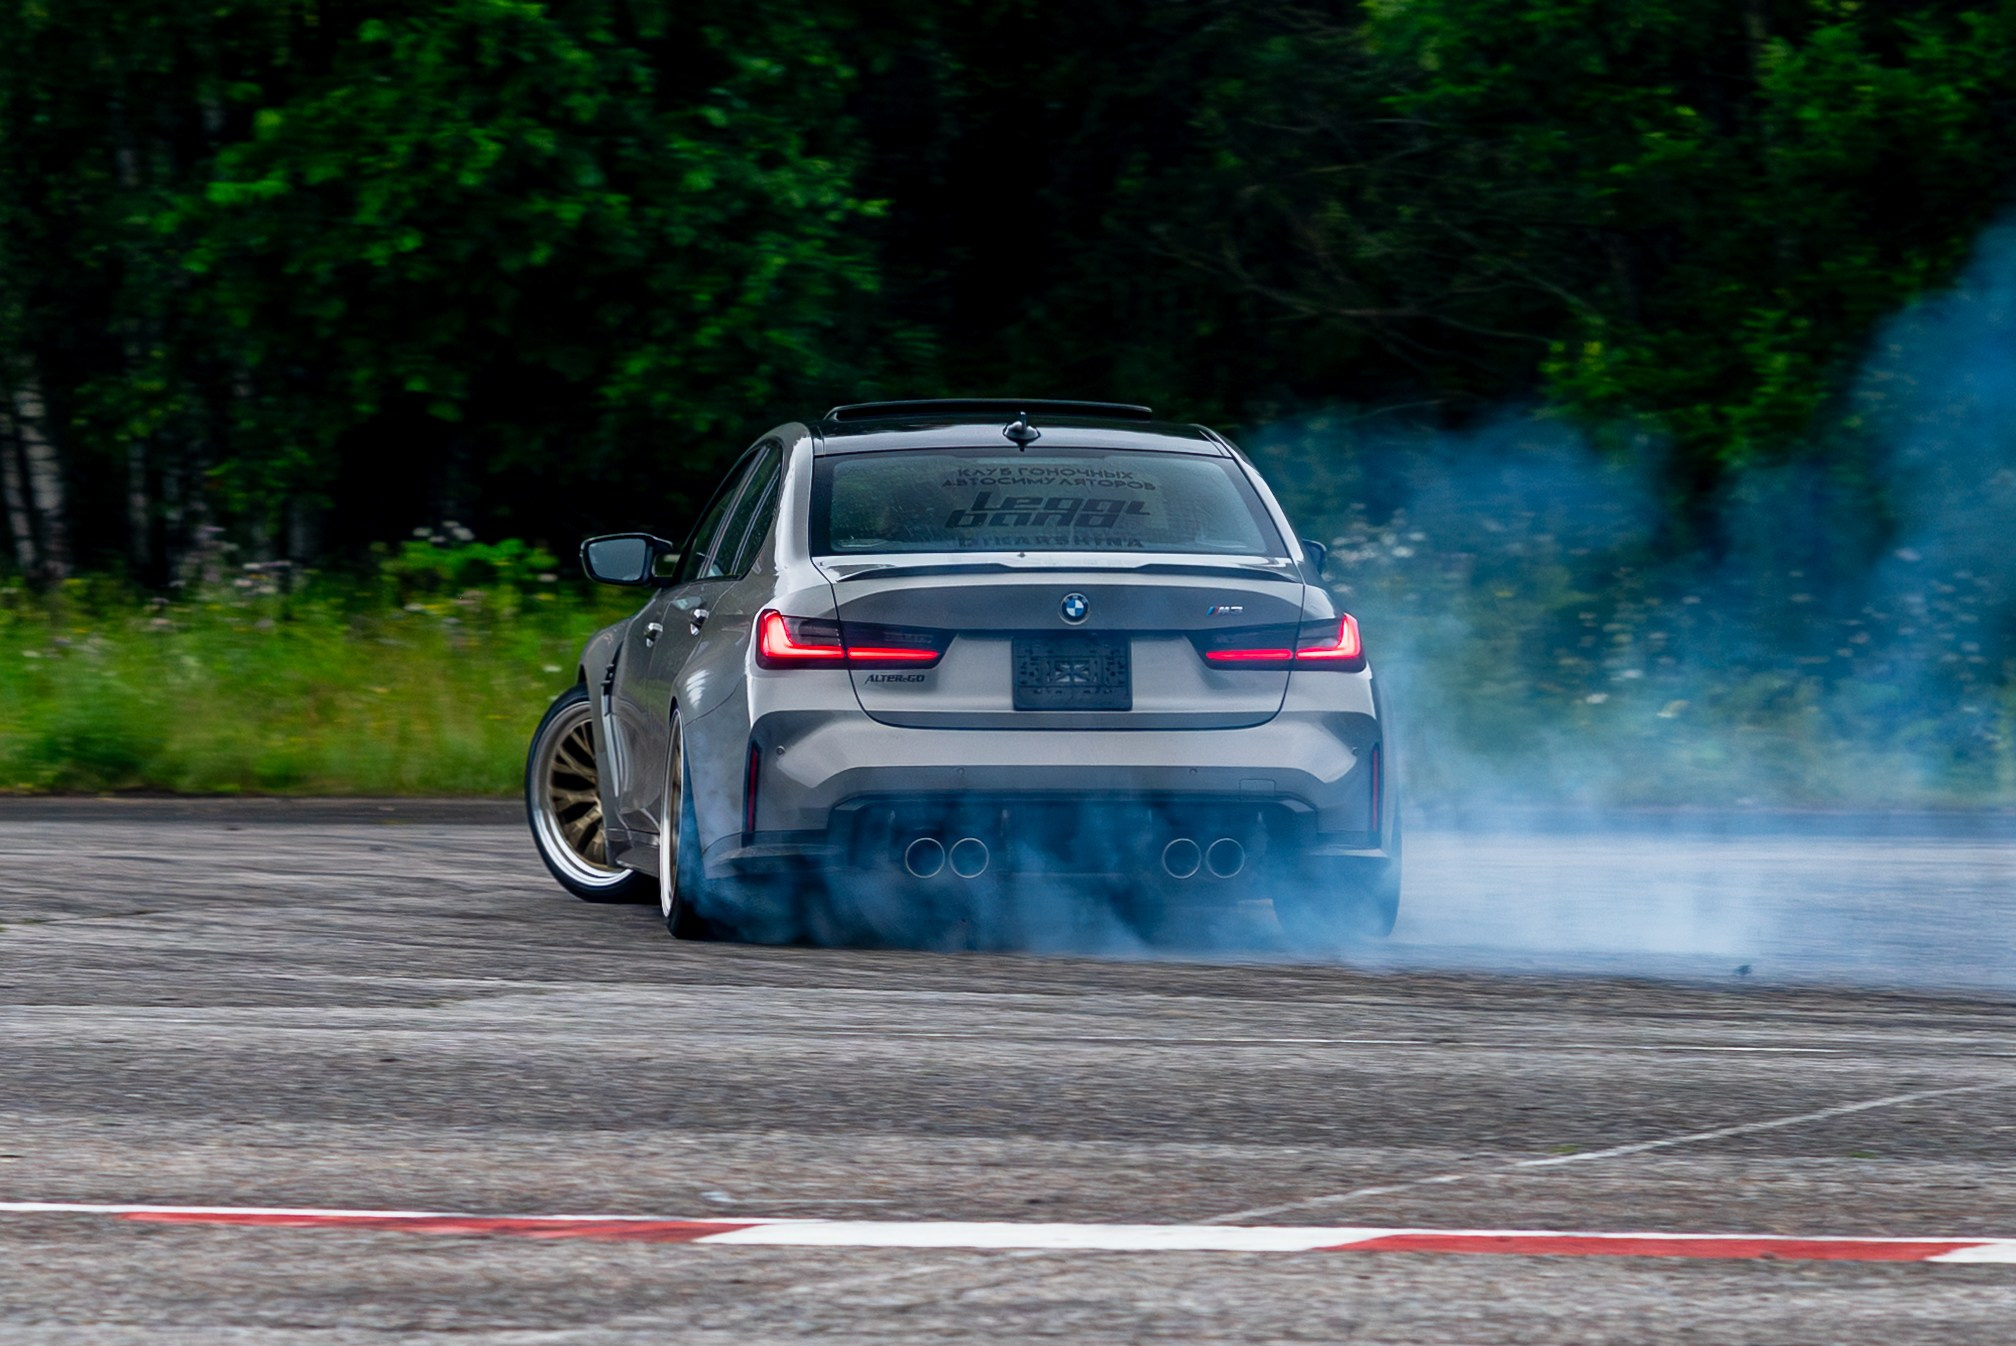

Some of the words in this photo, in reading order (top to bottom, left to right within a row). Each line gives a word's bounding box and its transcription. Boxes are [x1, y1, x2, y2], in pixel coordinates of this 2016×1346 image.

[958, 468, 1012, 477] КЛУБ
[1018, 467, 1133, 480] ГОНОЧНЫХ
[941, 476, 1157, 491] АВТОСИМУЛЯТОРОВ
